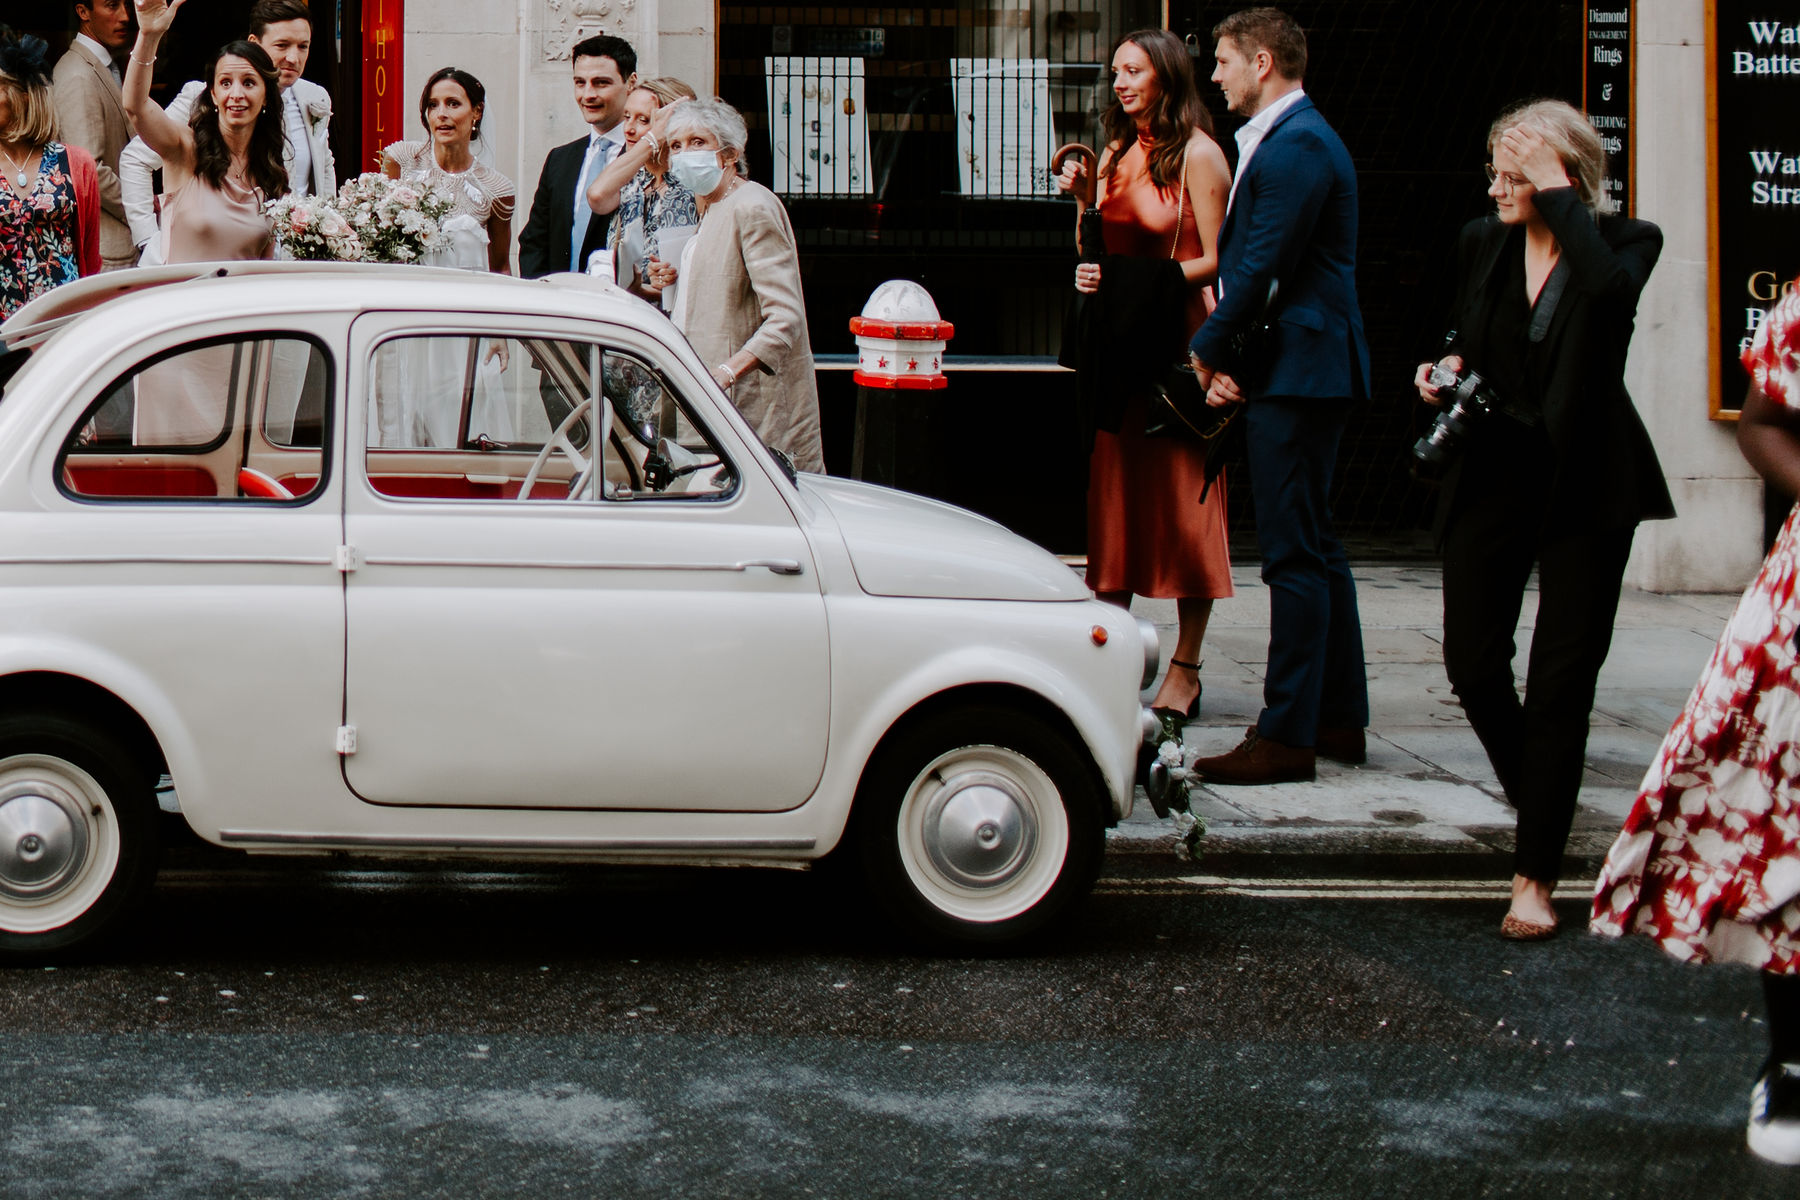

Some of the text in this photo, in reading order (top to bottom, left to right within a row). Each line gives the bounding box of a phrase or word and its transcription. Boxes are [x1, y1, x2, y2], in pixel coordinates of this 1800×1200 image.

[1589, 8, 1628, 23] Diamond
[1594, 45, 1623, 67] Rings
[1602, 83, 1613, 101] &
[1600, 133, 1622, 155] ings
